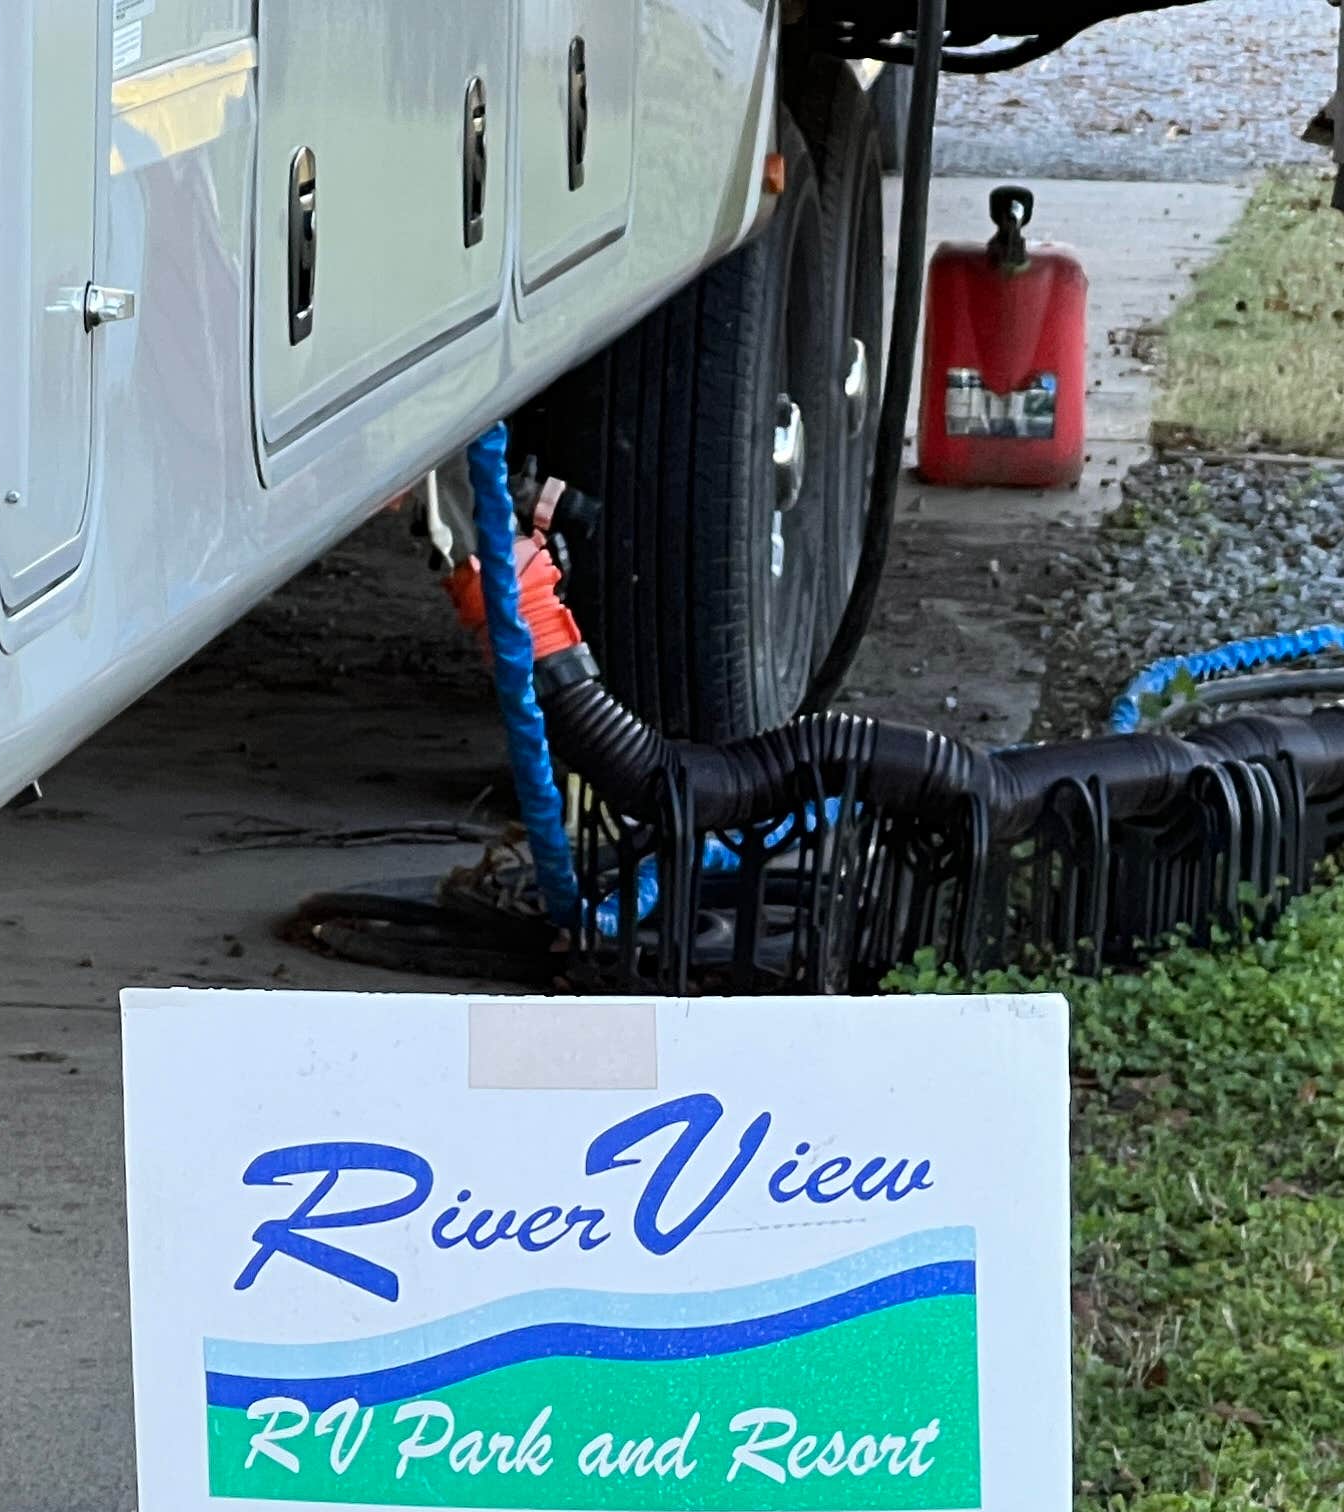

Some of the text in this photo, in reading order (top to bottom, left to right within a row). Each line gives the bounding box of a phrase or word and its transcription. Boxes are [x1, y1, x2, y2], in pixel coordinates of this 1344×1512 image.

[244, 1396, 942, 1483] RV Park and Resort
